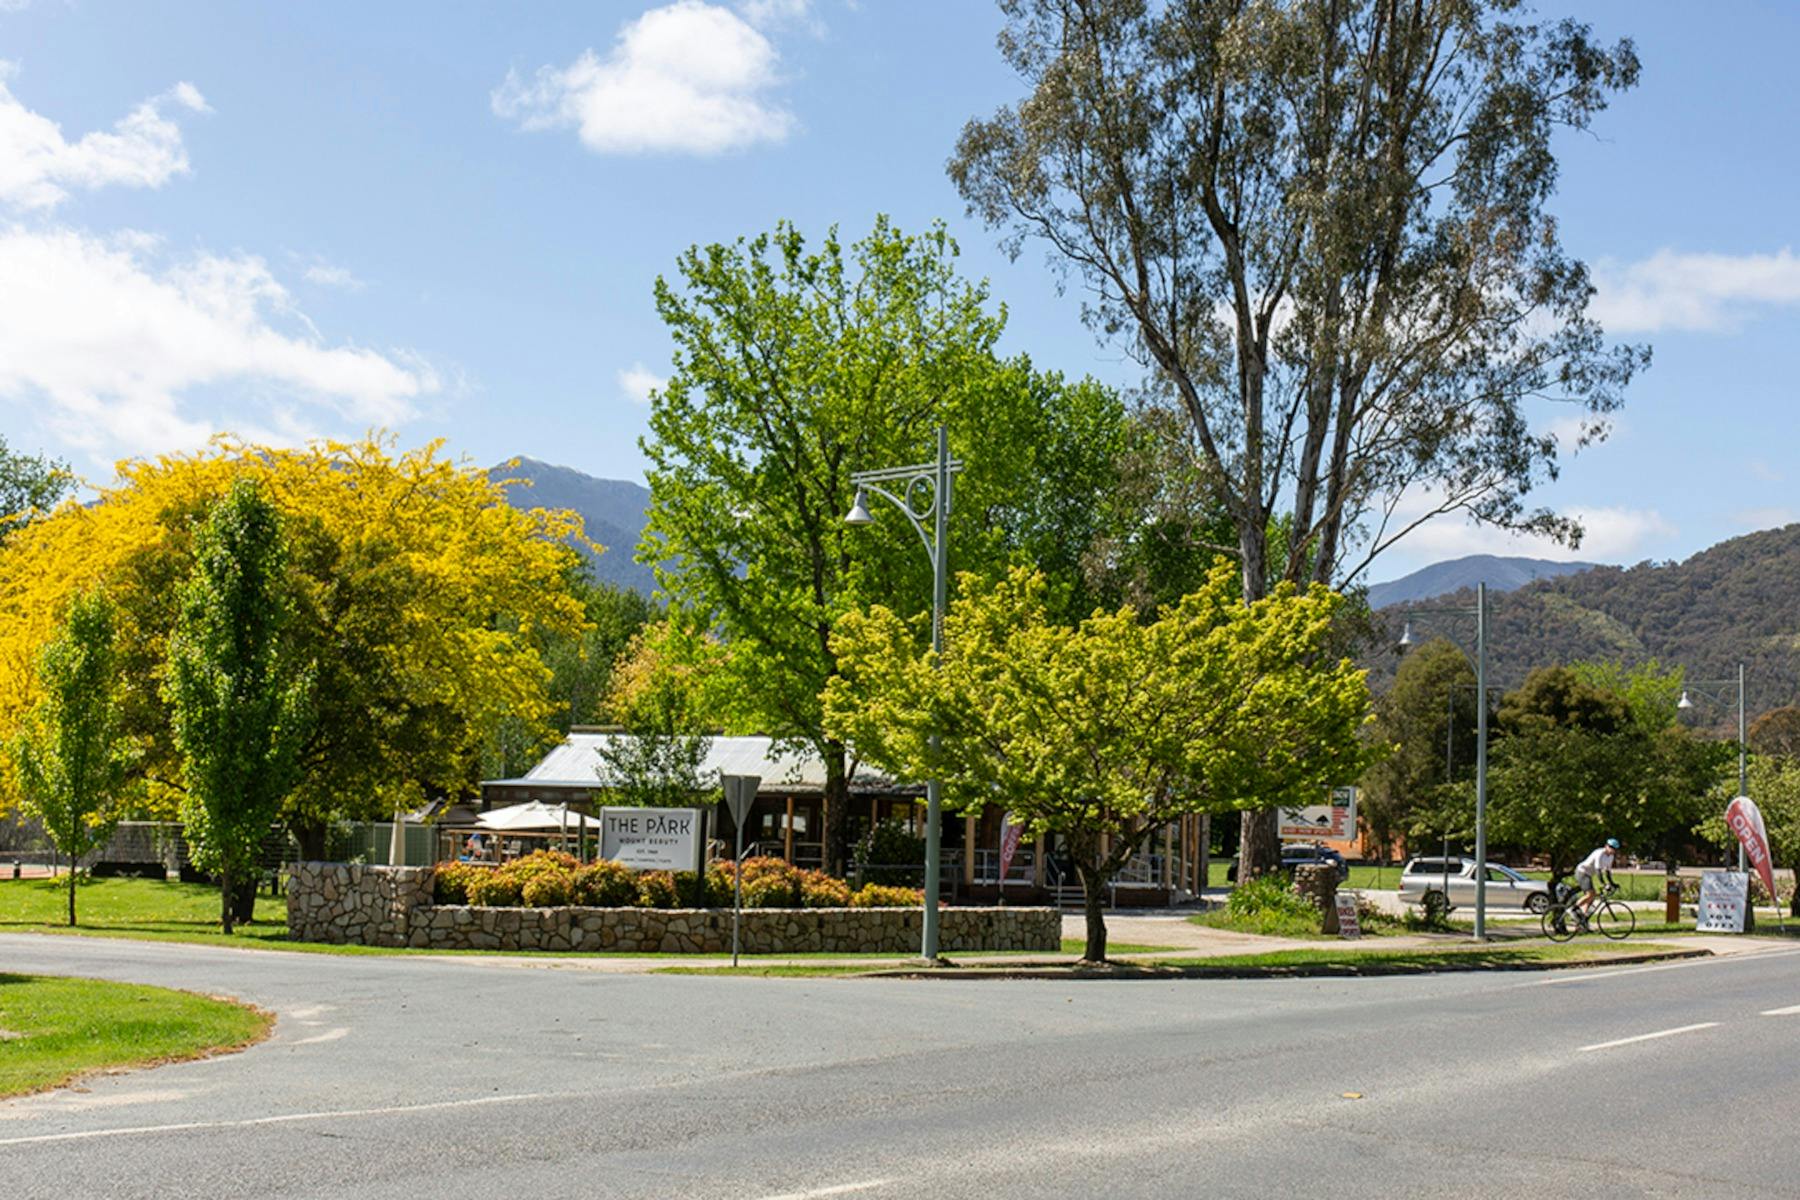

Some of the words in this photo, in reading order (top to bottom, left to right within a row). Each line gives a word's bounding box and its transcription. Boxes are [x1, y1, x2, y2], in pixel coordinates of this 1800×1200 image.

[609, 817, 638, 833] THE
[646, 815, 690, 834] PARK
[1733, 815, 1765, 864] OPEN
